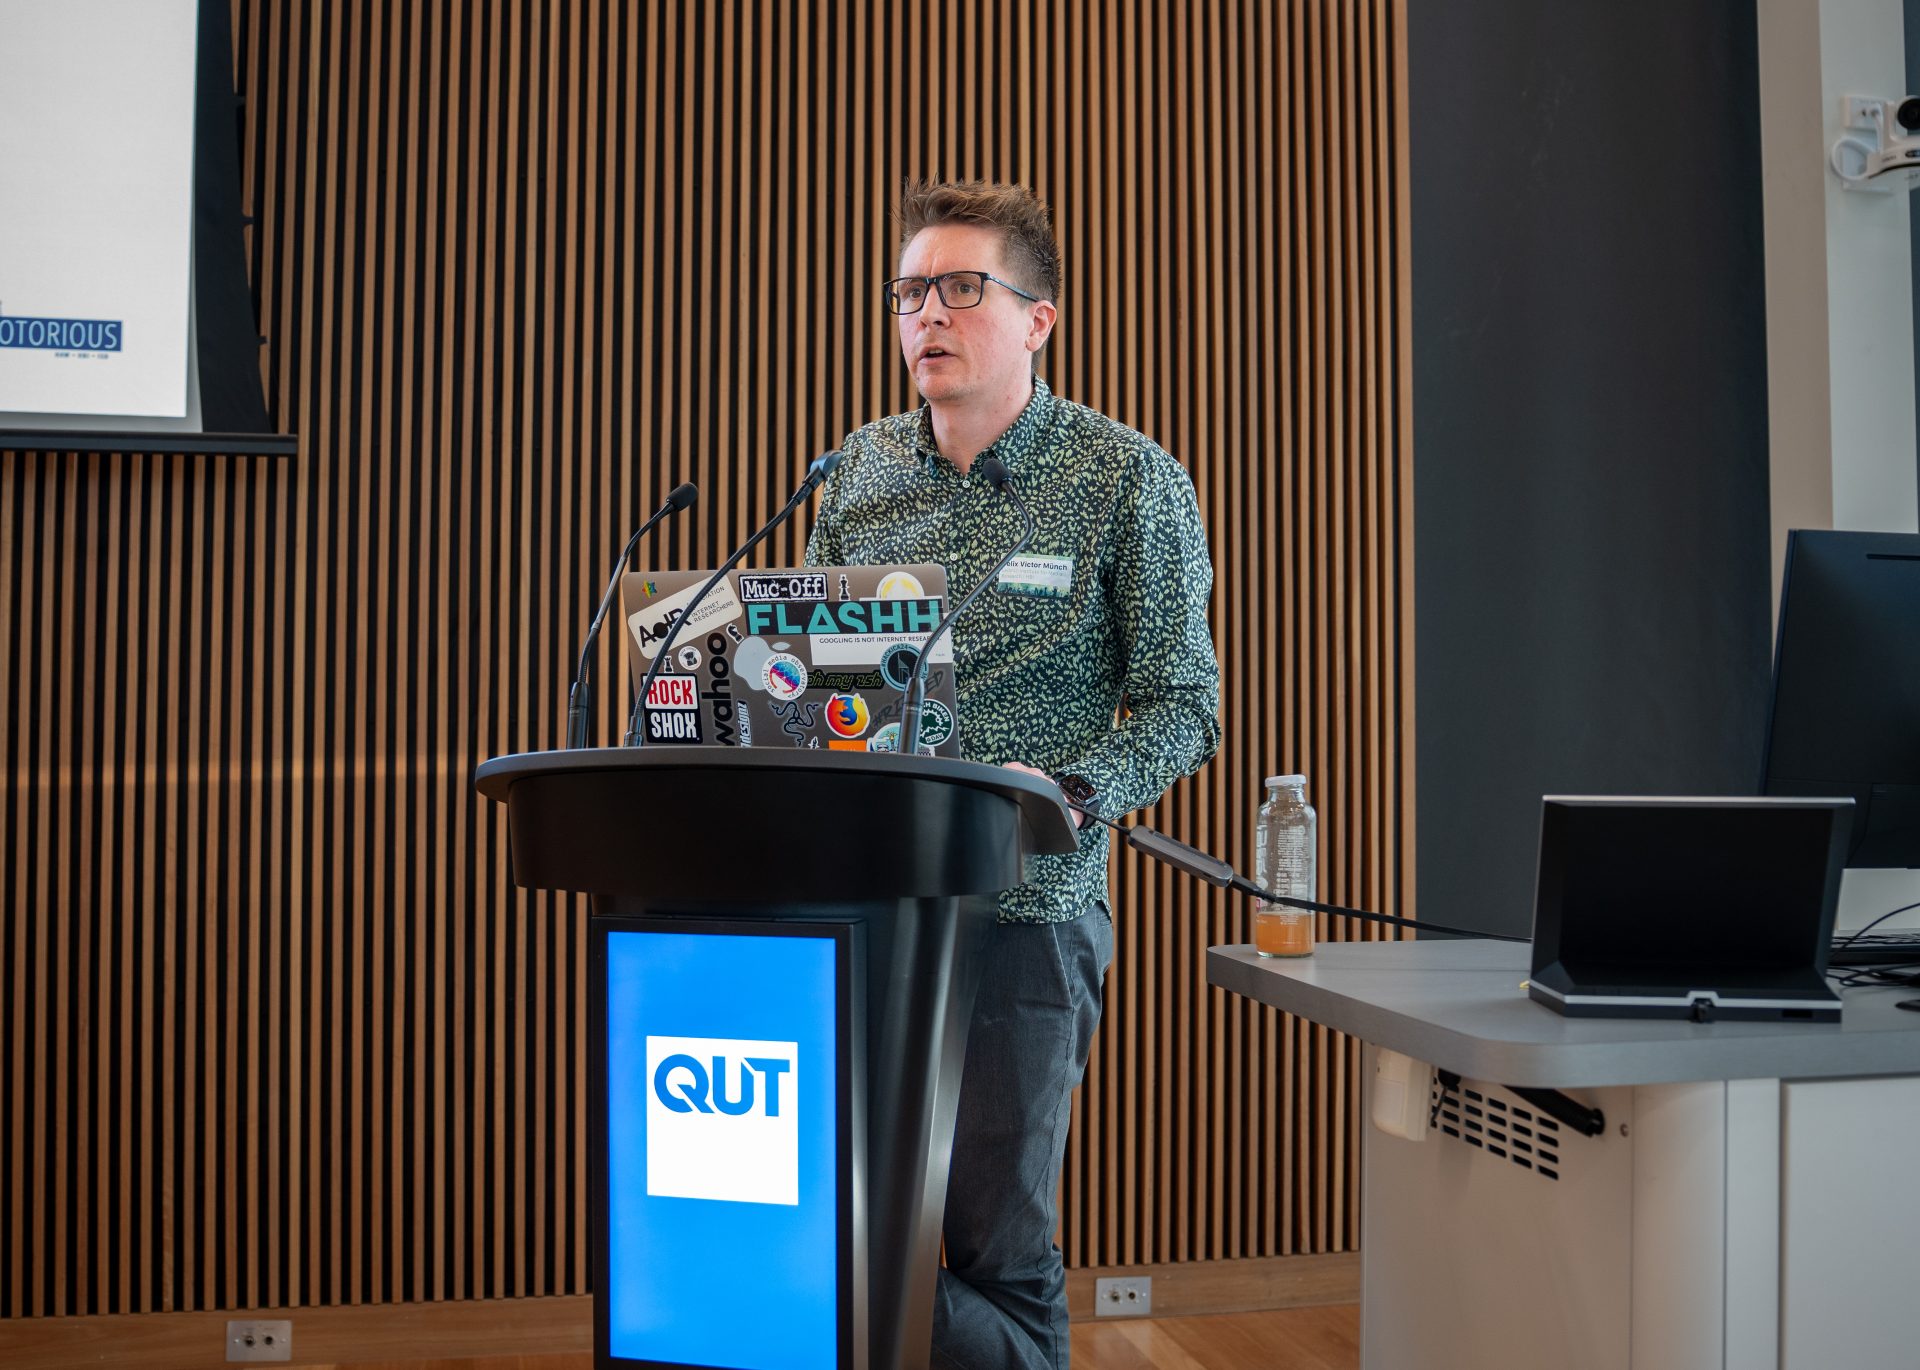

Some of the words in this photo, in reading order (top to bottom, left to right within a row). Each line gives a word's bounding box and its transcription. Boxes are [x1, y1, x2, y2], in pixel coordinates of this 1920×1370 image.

[1005, 560, 1019, 568] elix
[1020, 561, 1042, 569] Victor
[1042, 562, 1068, 571] Münch
[744, 577, 825, 598] Muc-Off
[691, 600, 720, 618] INTERNET
[693, 600, 735, 622] RESEARCHERS
[747, 600, 941, 635] FLASHH
[767, 655, 787, 666] media
[701, 632, 736, 747] wahoo
[825, 674, 854, 690] my
[856, 671, 883, 687] zsh
[647, 679, 694, 705] ROCK
[650, 711, 697, 739] SHOX
[654, 1053, 791, 1117] QUT
